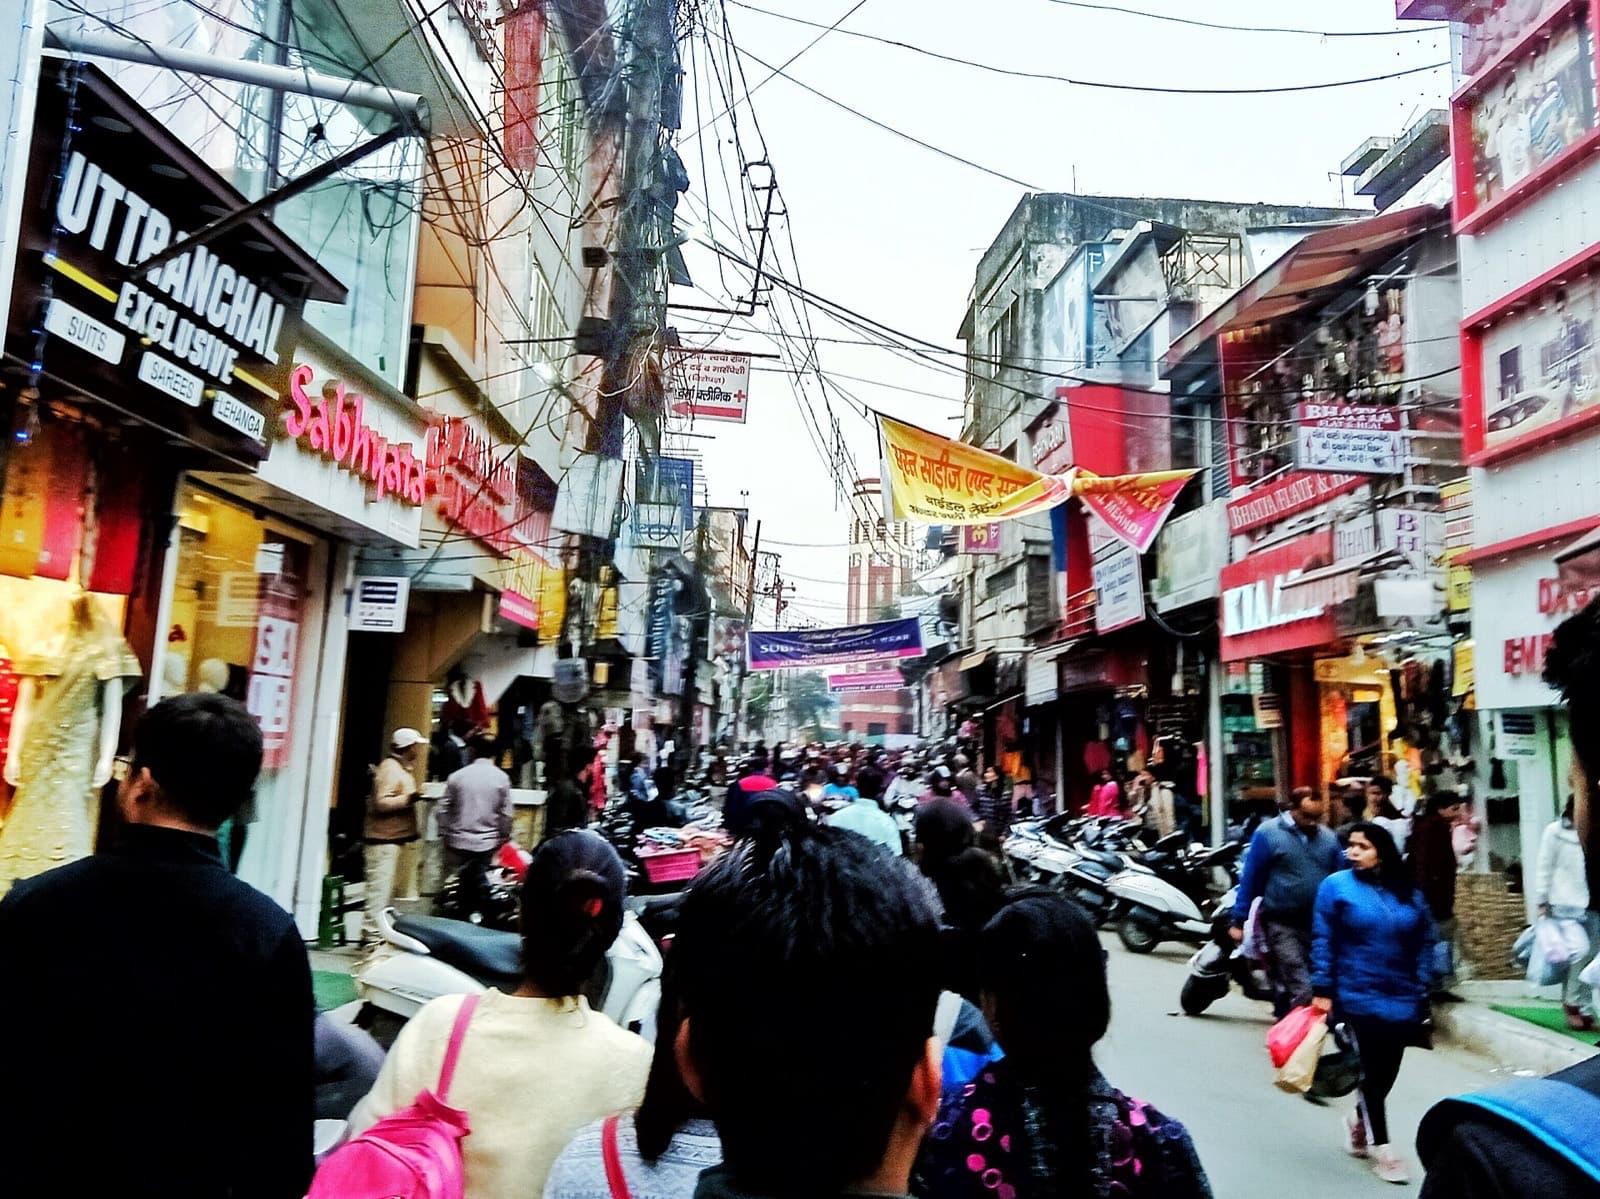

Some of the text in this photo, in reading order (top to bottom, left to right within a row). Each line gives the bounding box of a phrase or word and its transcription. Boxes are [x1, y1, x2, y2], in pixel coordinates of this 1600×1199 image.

[57, 151, 285, 366] UTTRANCHAL
[67, 315, 108, 353] SUITS
[114, 281, 239, 385] EXCLUSIVE
[150, 361, 195, 400] SAREES
[216, 397, 261, 436] LEHANGA
[285, 363, 426, 504] Sabhyata
[1104, 500, 1144, 537] MEHNDI
